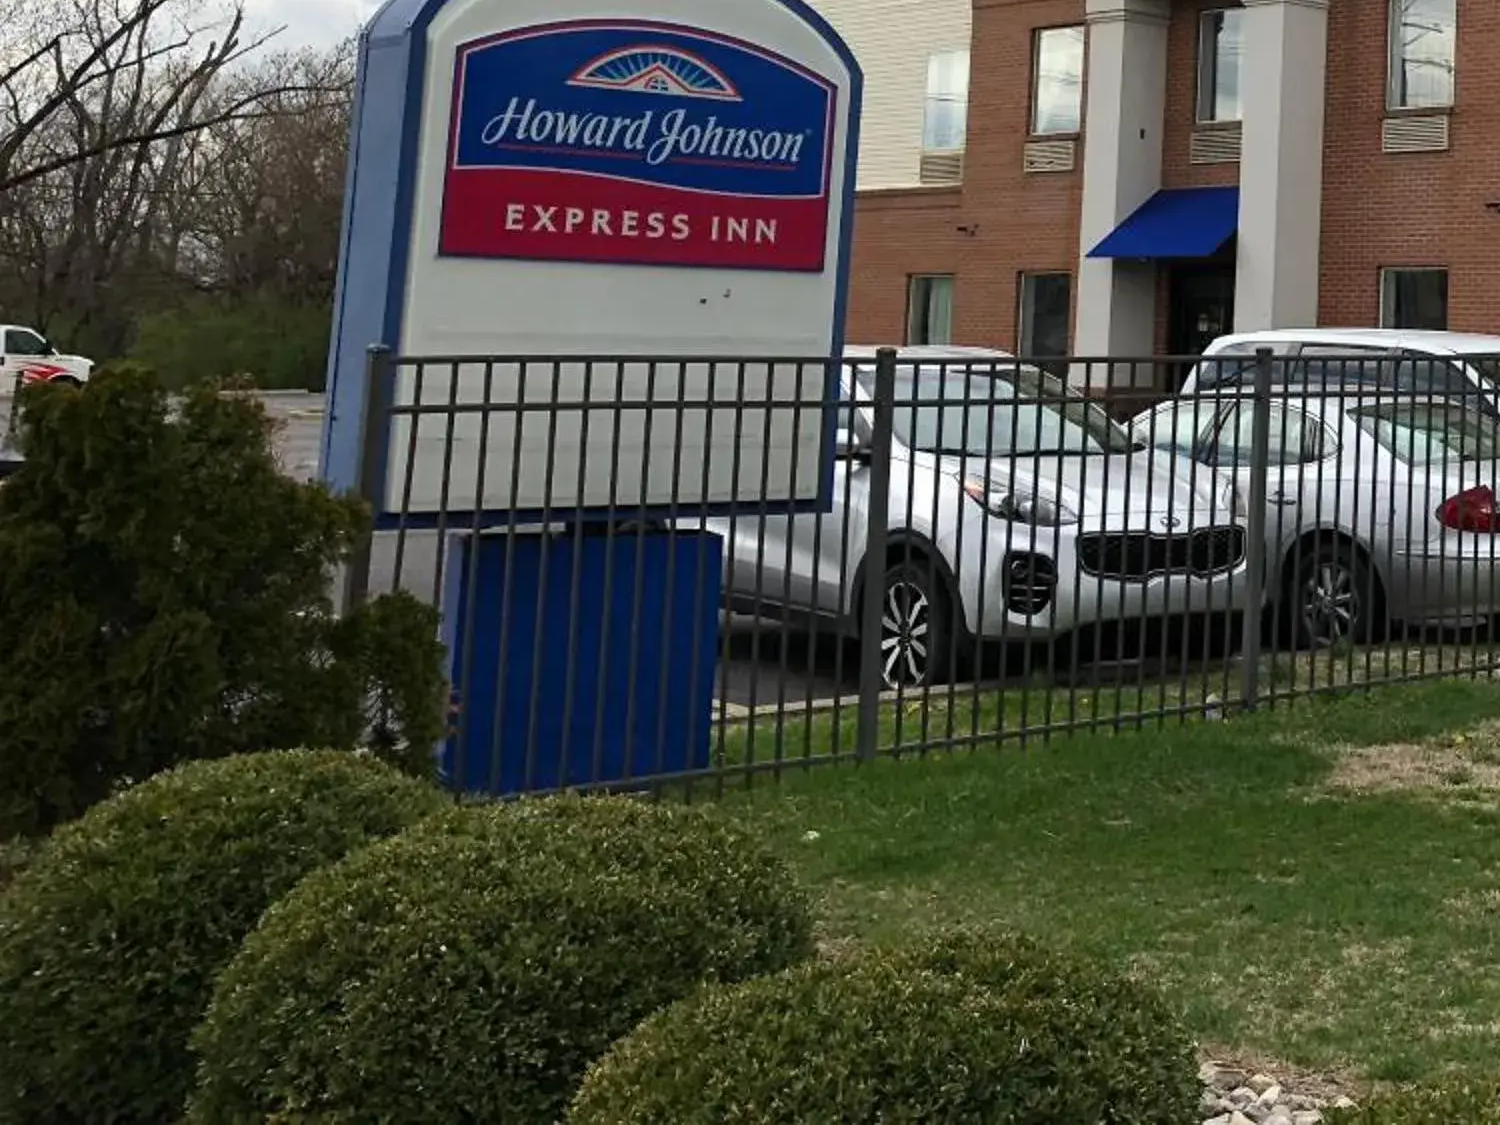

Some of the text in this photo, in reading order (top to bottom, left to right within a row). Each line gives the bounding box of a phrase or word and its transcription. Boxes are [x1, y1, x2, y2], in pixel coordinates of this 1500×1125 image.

[481, 96, 804, 166] Howard Johnson
[504, 203, 779, 244] EXPRESS INN
